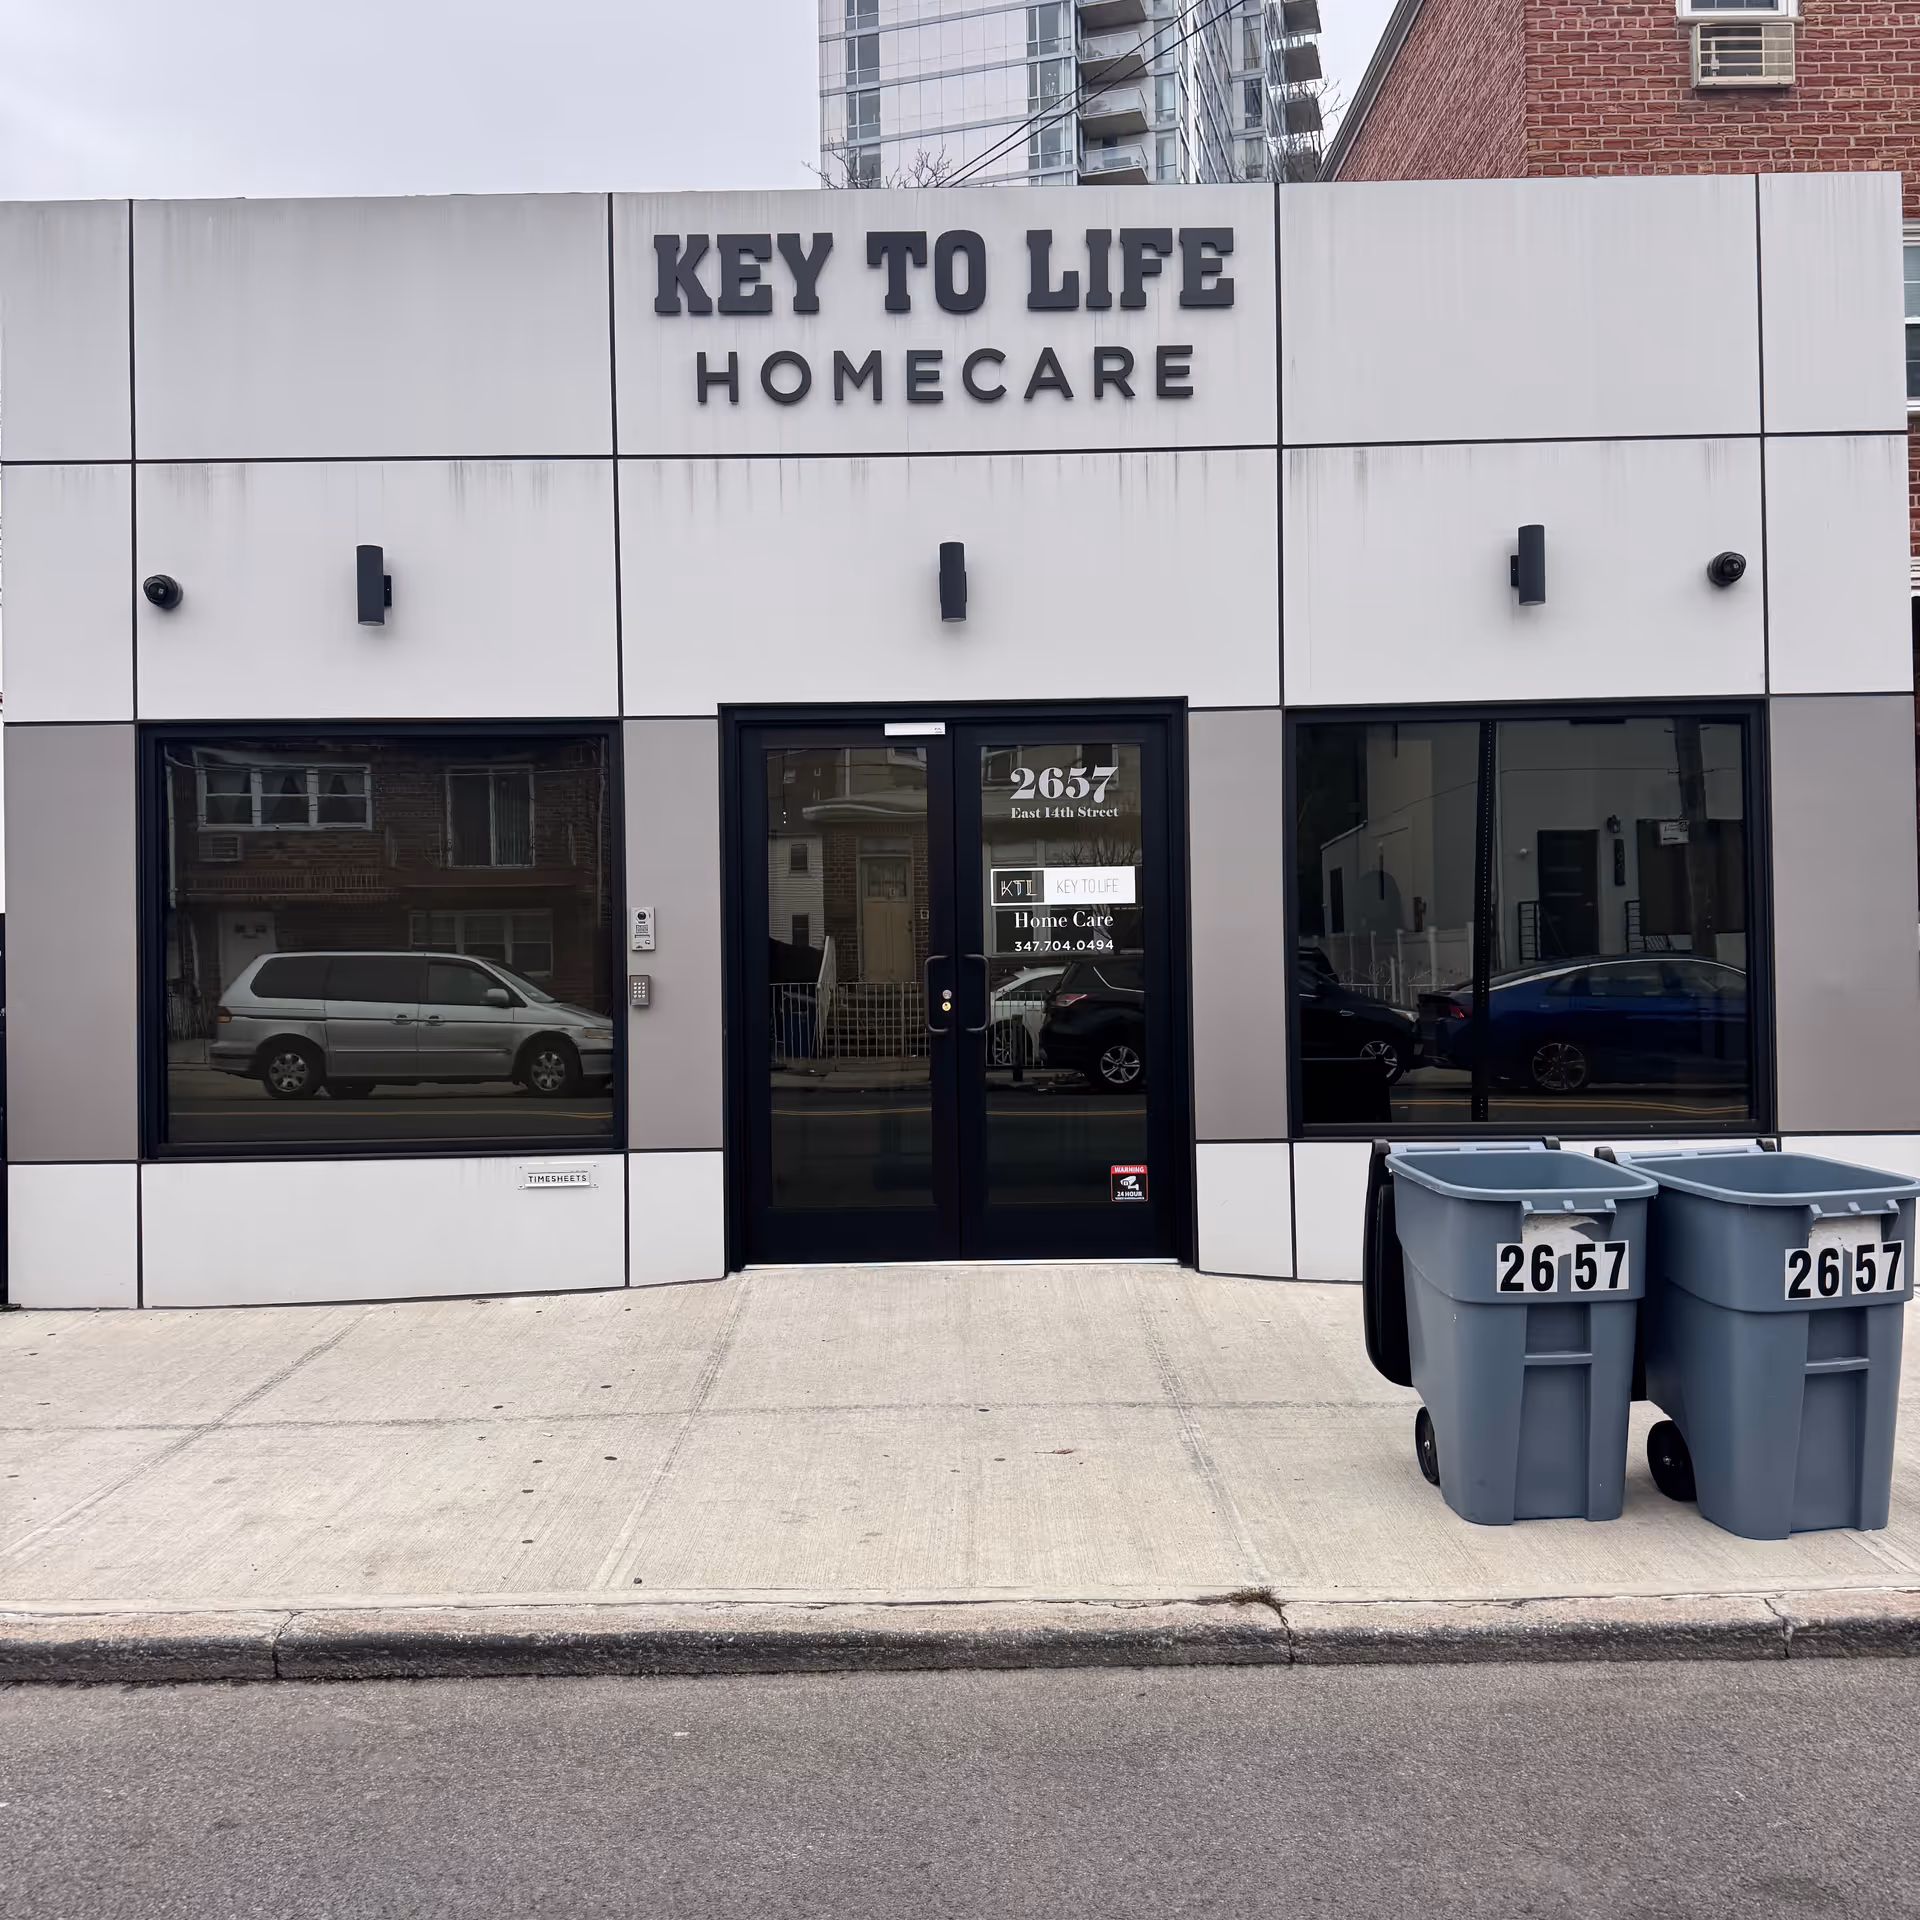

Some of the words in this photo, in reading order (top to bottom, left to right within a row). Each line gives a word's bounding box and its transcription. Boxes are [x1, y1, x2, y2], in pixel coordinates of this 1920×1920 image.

[654, 232, 833, 314] KEY
[866, 229, 987, 315] TO
[1026, 227, 1234, 311] LIFE
[696, 345, 1194, 404] HOMECARE
[1010, 764, 1119, 803] 2657
[1011, 807, 1041, 819] East
[1044, 806, 1074, 818] 14th
[1077, 805, 1119, 818] Street
[1000, 879, 1038, 897] KTL
[1056, 879, 1078, 894] KEY
[1081, 878, 1096, 893] TO
[1098, 878, 1119, 893] LIFE
[1014, 911, 1068, 928] Home
[1073, 910, 1114, 927] Care
[1014, 939, 1114, 952] 347.704.0494
[528, 1174, 587, 1183] TIMESHEETS
